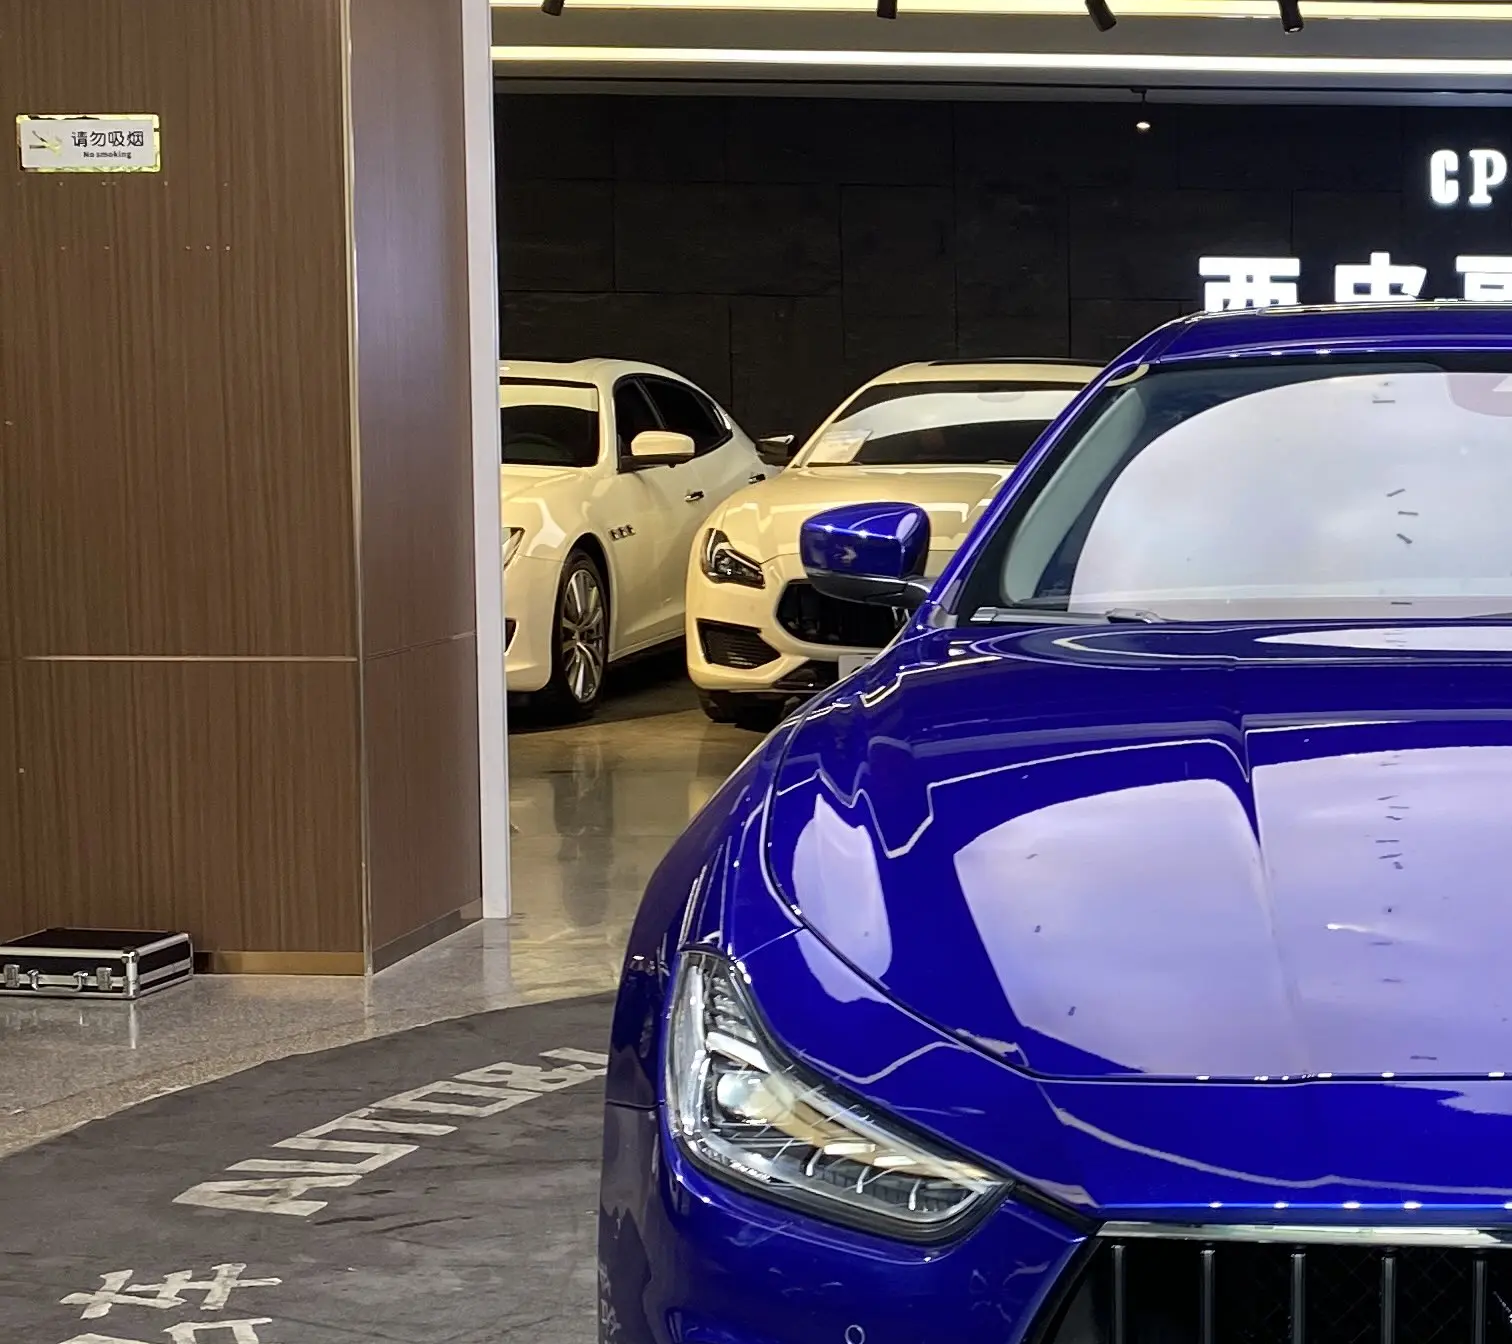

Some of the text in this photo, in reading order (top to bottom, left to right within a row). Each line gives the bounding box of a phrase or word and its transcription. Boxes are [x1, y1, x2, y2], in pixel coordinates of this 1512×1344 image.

[72, 130, 144, 147] 请勿吸烟
[172, 1046, 609, 1217] AUTO&
